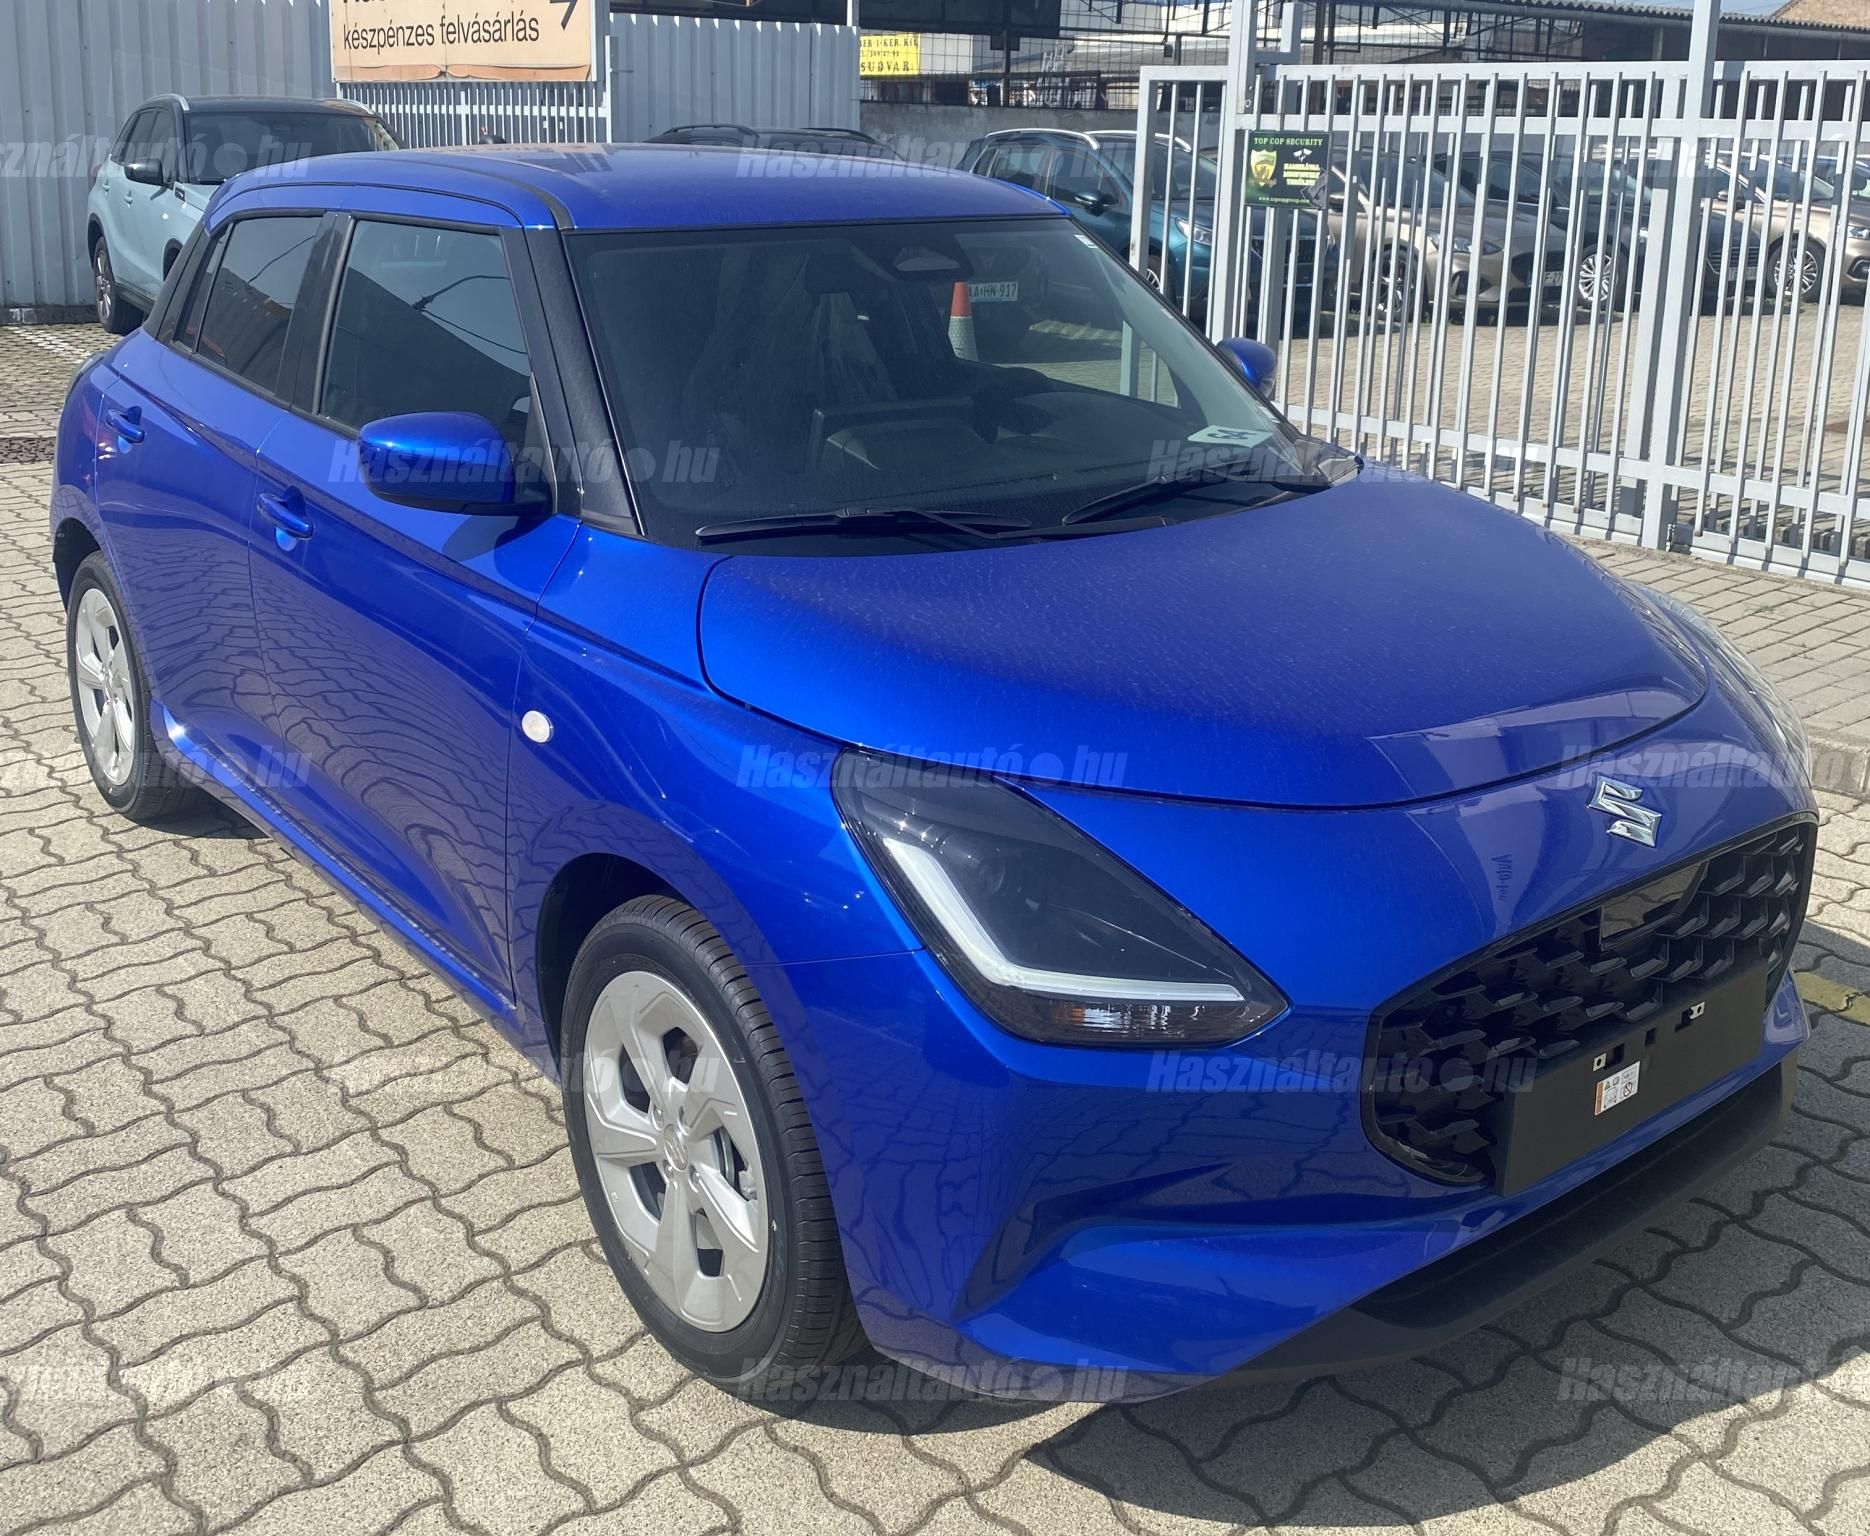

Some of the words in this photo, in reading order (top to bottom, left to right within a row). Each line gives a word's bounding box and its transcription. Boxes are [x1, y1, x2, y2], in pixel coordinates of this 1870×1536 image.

[343, 19, 435, 55] készpénzes
[439, 10, 540, 45] felvásárlás
[1286, 138, 1323, 146] SECURITY
